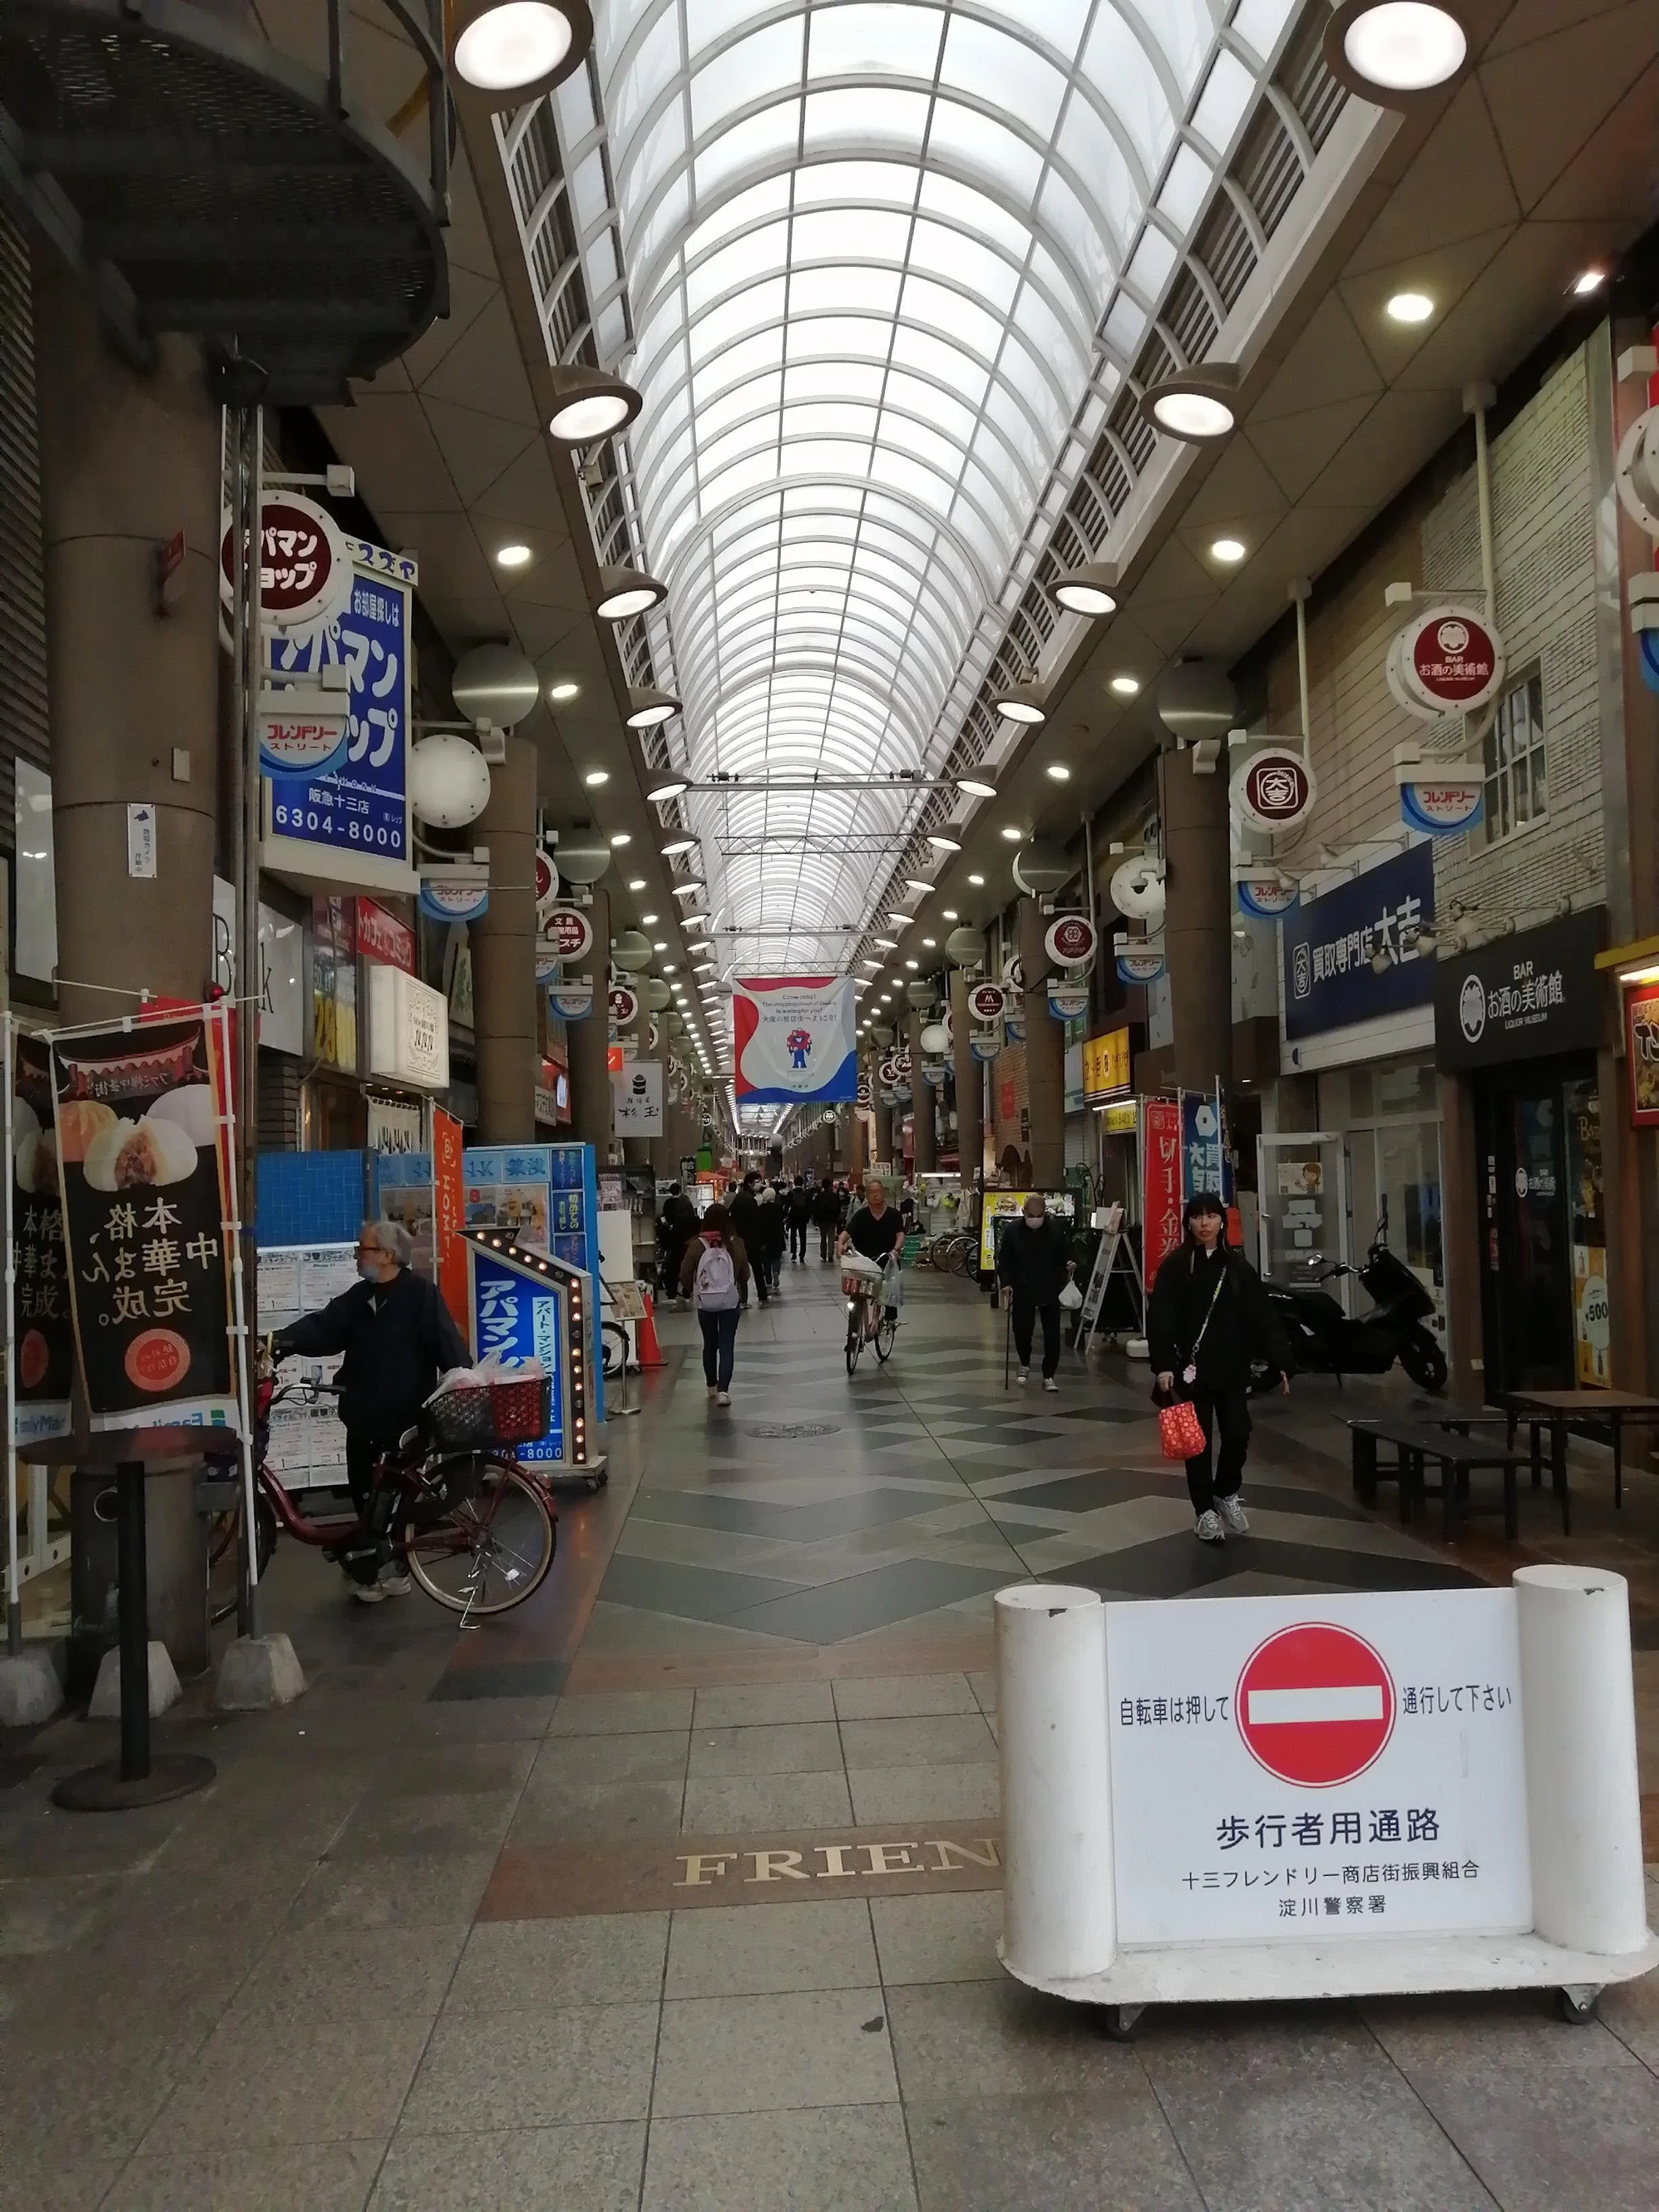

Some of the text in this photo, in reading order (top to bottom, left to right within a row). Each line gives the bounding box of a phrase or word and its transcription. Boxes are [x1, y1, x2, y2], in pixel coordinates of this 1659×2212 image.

[244, 527, 317, 557] パマン
[244, 560, 318, 590] ョップ
[353, 588, 400, 628] お部屋探しは
[1419, 661, 1489, 676] お酒の美術館
[1445, 655, 1464, 663] BAR
[267, 724, 338, 740] フレンドリー
[270, 743, 333, 752] ストリート
[309, 787, 370, 815] 阪急十三店
[1423, 790, 1476, 804] フレンドリー
[275, 805, 401, 848] 6304-8000
[1312, 895, 1422, 983] 買取専門店 大吉
[1513, 960, 1534, 981] BAR
[1488, 970, 1563, 1019] お酒の美術館
[617, 1105, 659, 1118] 杉玉
[1584, 1301, 1609, 1323] ¥500
[1120, 1685, 1512, 1727] 自転車は押して 通行して下さい
[1216, 1807, 1440, 1850] 歩行者用通路
[672, 1837, 1002, 1887] FRIEN
[1181, 1860, 1480, 1891] 十三フレンドリー商店街振興組合
[1278, 1894, 1387, 1917] 淀川警察署
